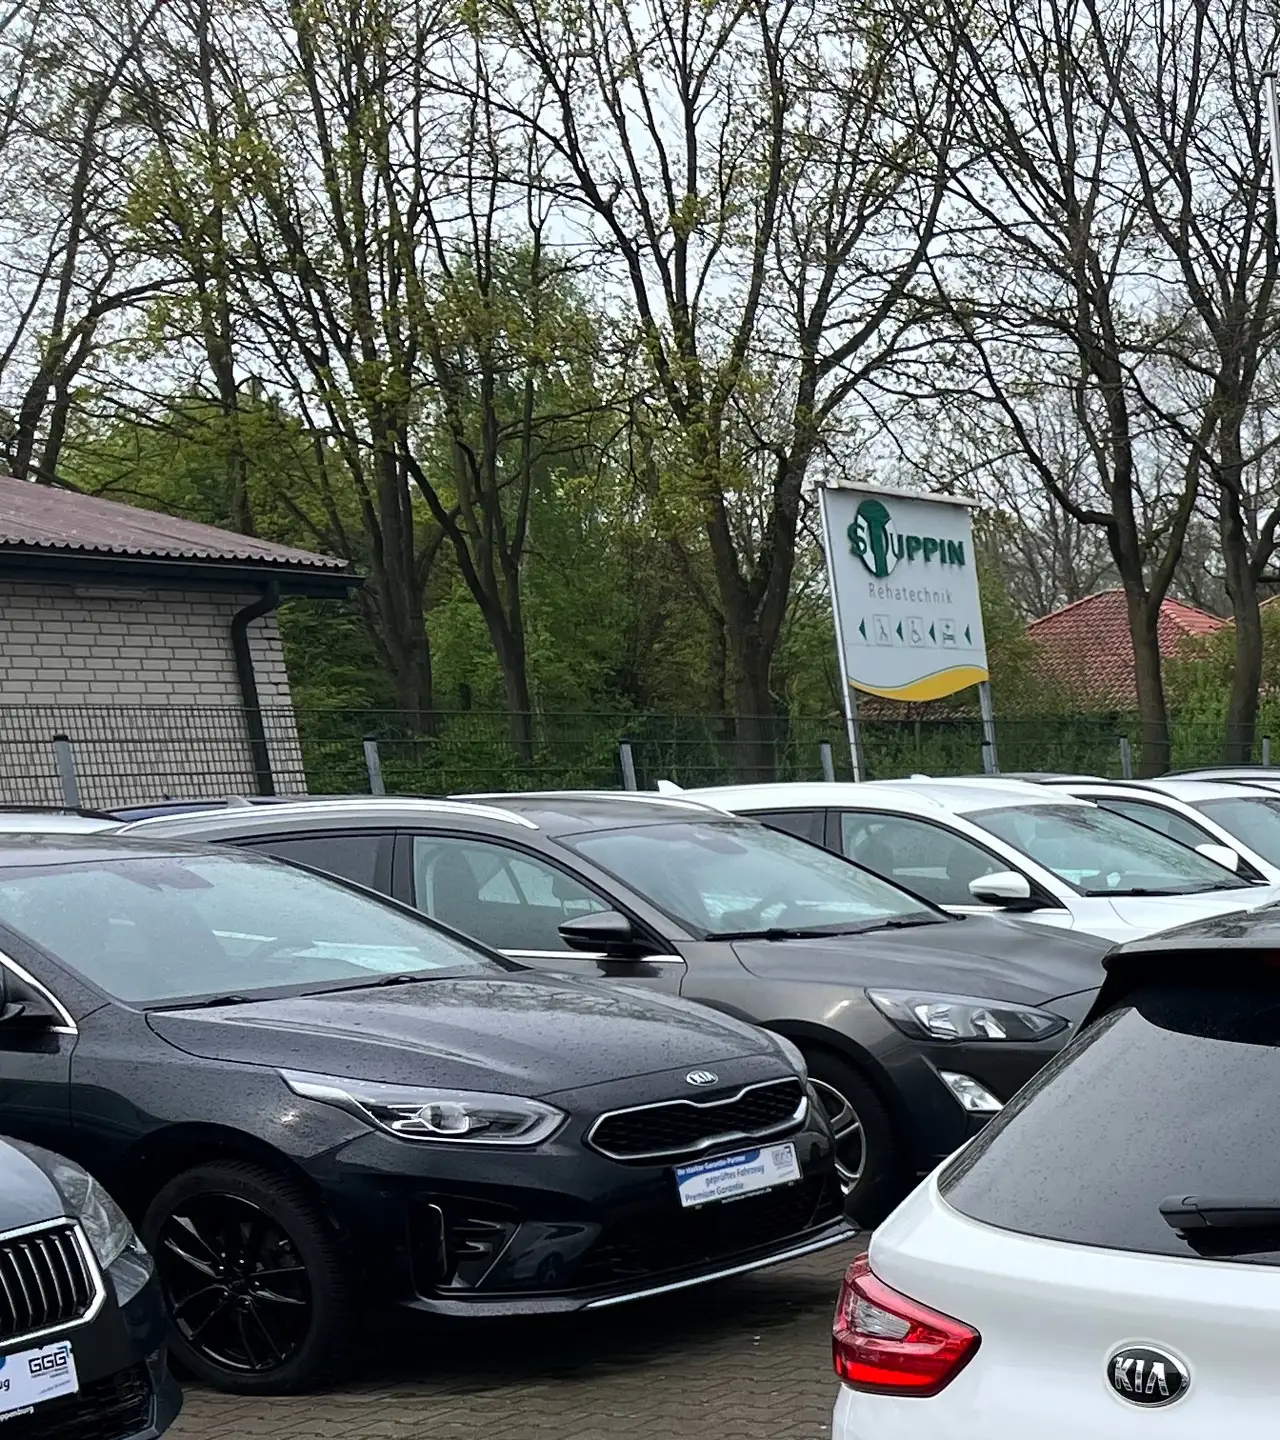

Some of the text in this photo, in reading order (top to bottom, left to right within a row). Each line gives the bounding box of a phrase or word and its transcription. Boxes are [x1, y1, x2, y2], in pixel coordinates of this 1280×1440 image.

[868, 582, 953, 604] Rehatechnik
[28, 1351, 67, 1374] GGG
[1114, 1357, 1170, 1396] KIA
